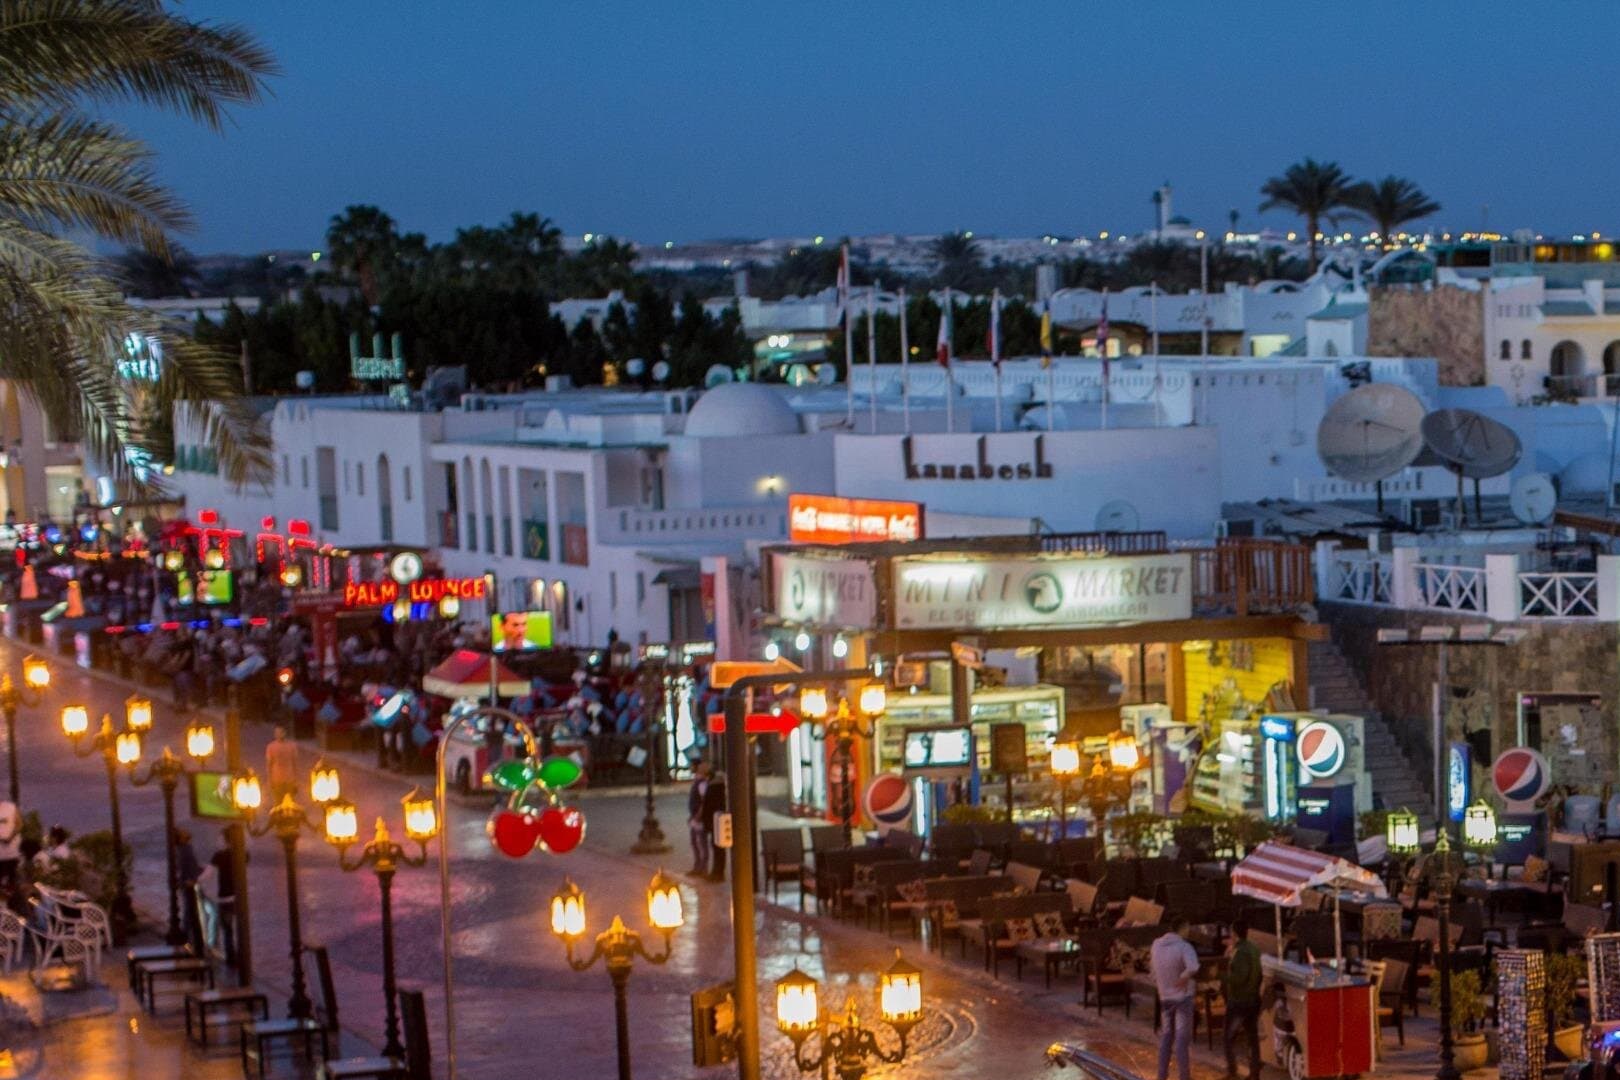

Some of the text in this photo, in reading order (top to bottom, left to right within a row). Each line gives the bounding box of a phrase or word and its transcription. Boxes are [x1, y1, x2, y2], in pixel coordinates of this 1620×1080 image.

[344, 578, 486, 606] PALM LOUNGE
[904, 566, 1186, 604] MINI MARKET
